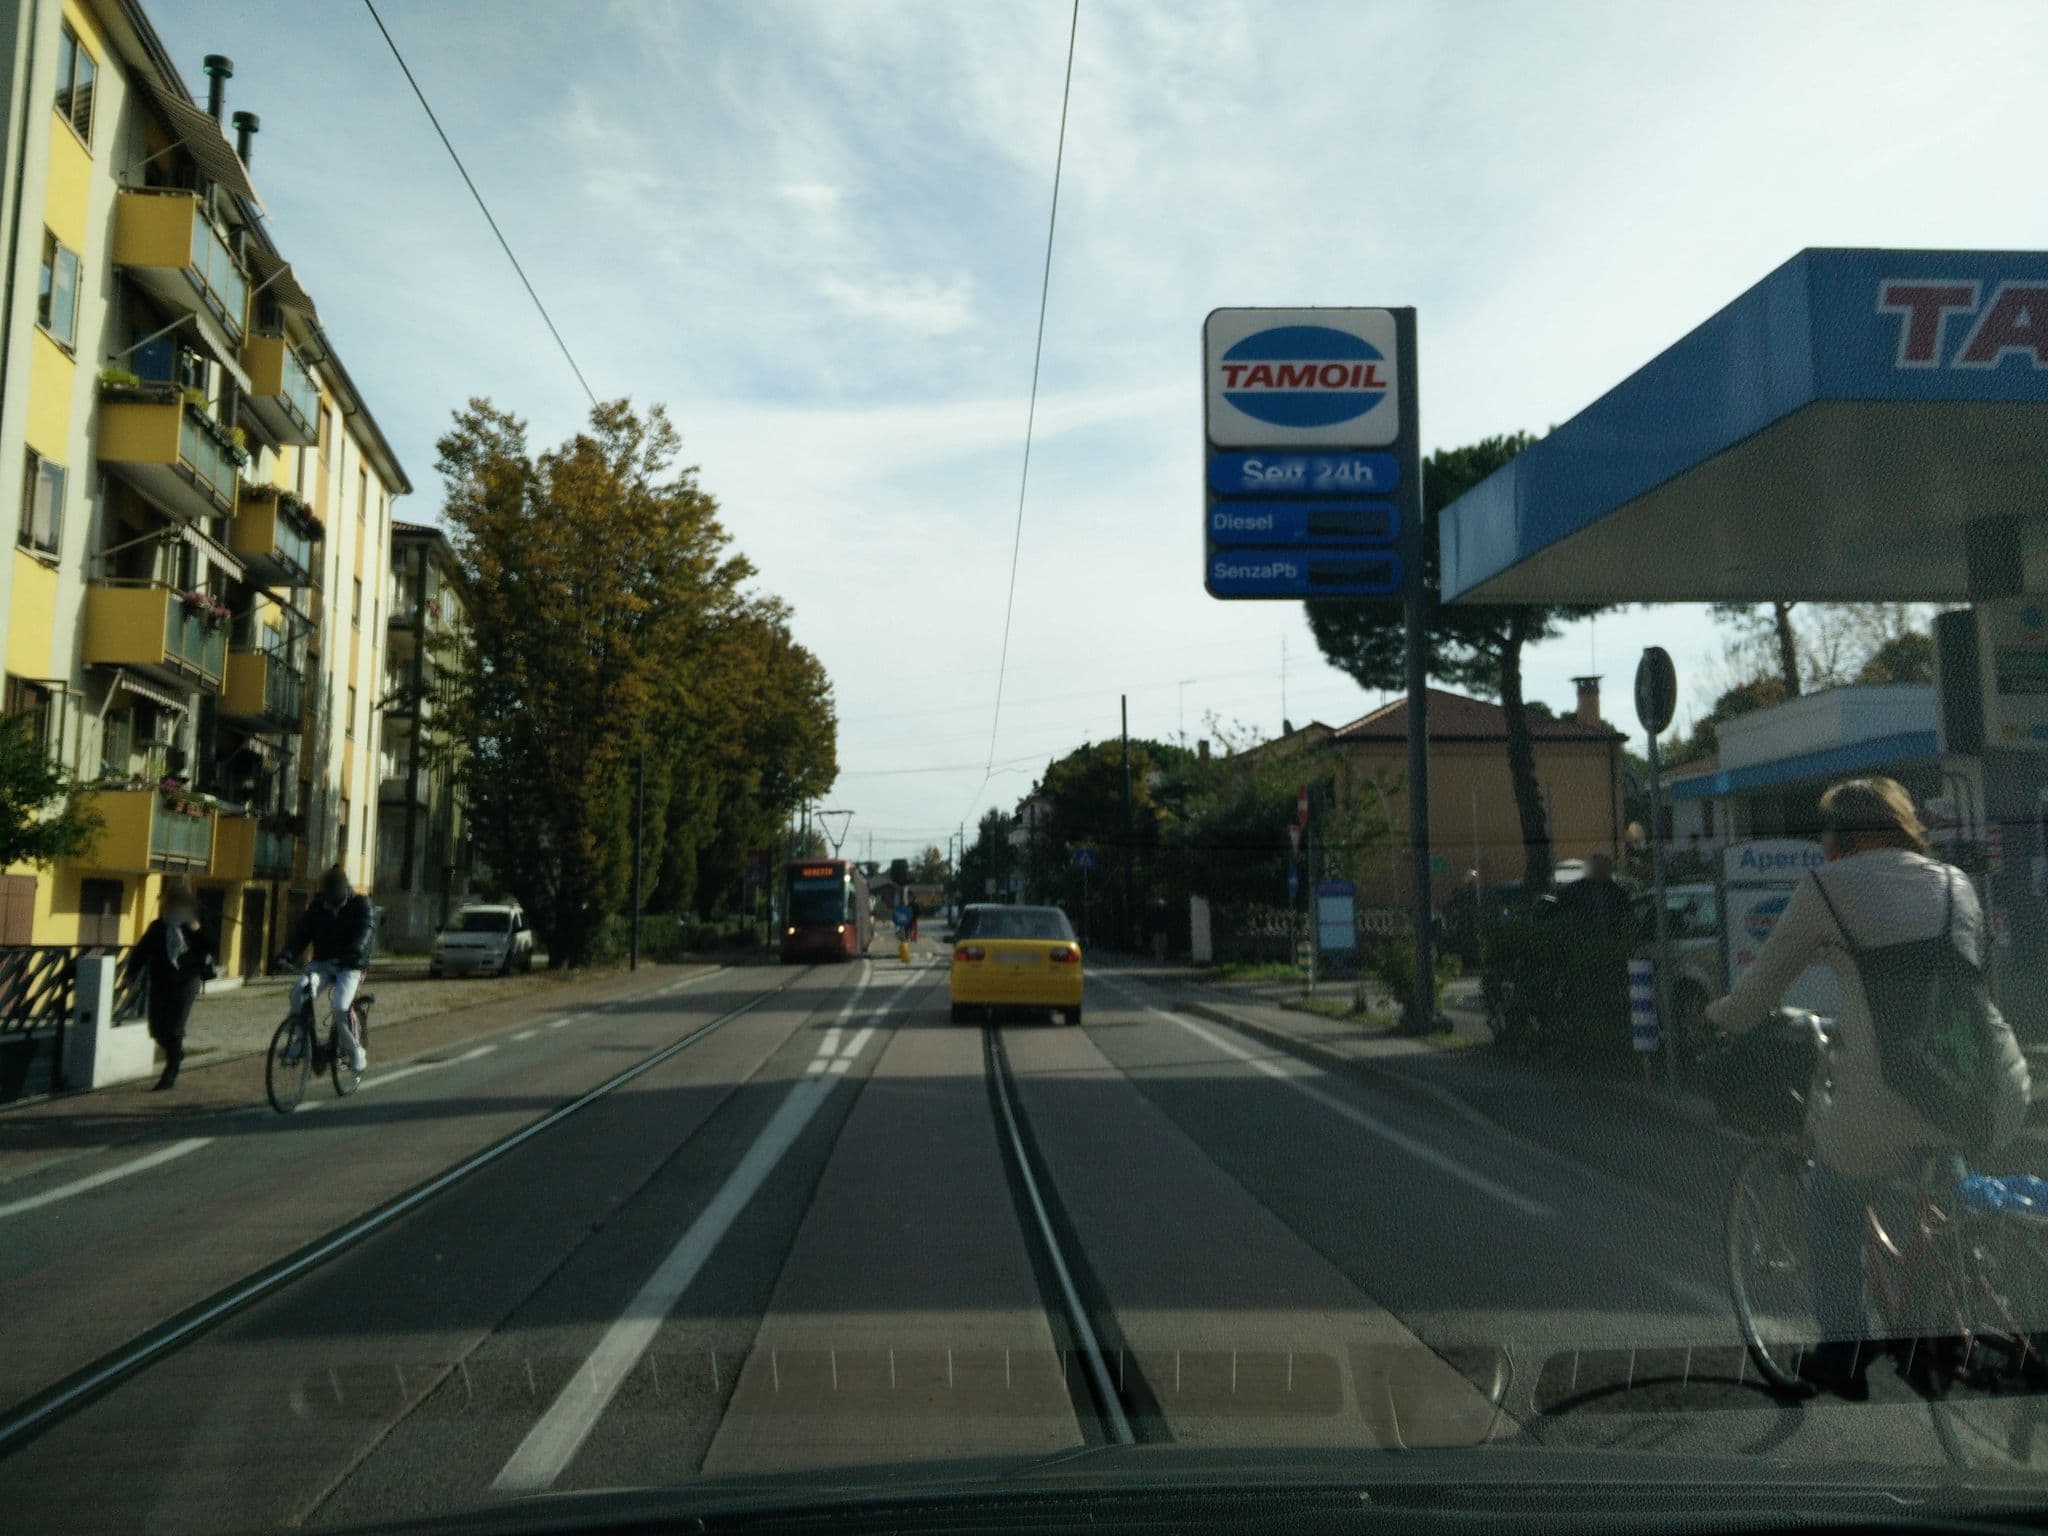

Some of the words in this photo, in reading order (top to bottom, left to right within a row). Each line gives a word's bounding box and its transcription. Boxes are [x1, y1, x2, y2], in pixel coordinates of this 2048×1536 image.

[1876, 277, 2048, 371] TA
[1221, 363, 1387, 389] TAMOIL
[1319, 460, 1374, 481] 24h
[1213, 512, 1273, 530] Diesel
[1214, 562, 1297, 579] SenzaPb
